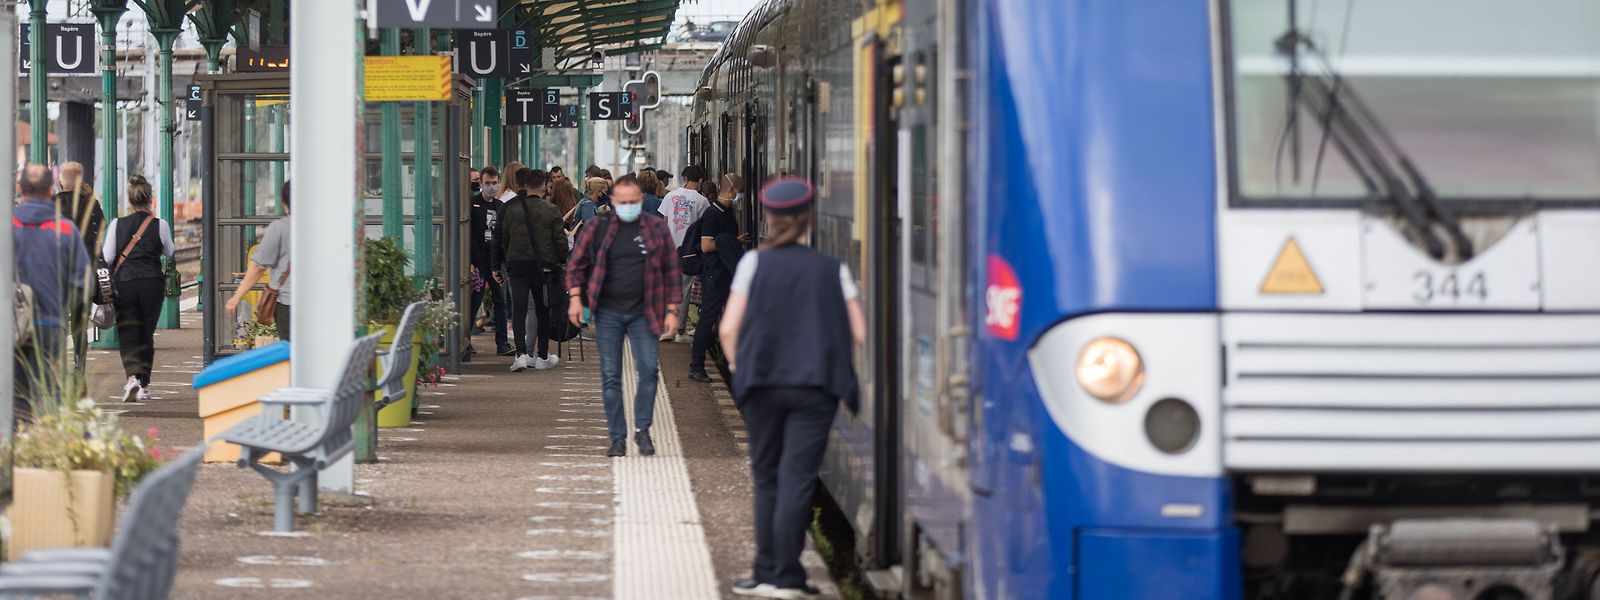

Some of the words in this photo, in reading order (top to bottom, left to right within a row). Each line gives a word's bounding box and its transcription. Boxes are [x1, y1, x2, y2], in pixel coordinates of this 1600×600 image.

[56, 35, 82, 69] U
[515, 36, 526, 47] D
[470, 41, 496, 74] U
[192, 90, 200, 99] C
[547, 94, 556, 103] D
[516, 97, 533, 122] T
[598, 98, 611, 118] S
[1411, 270, 1488, 303] 344
